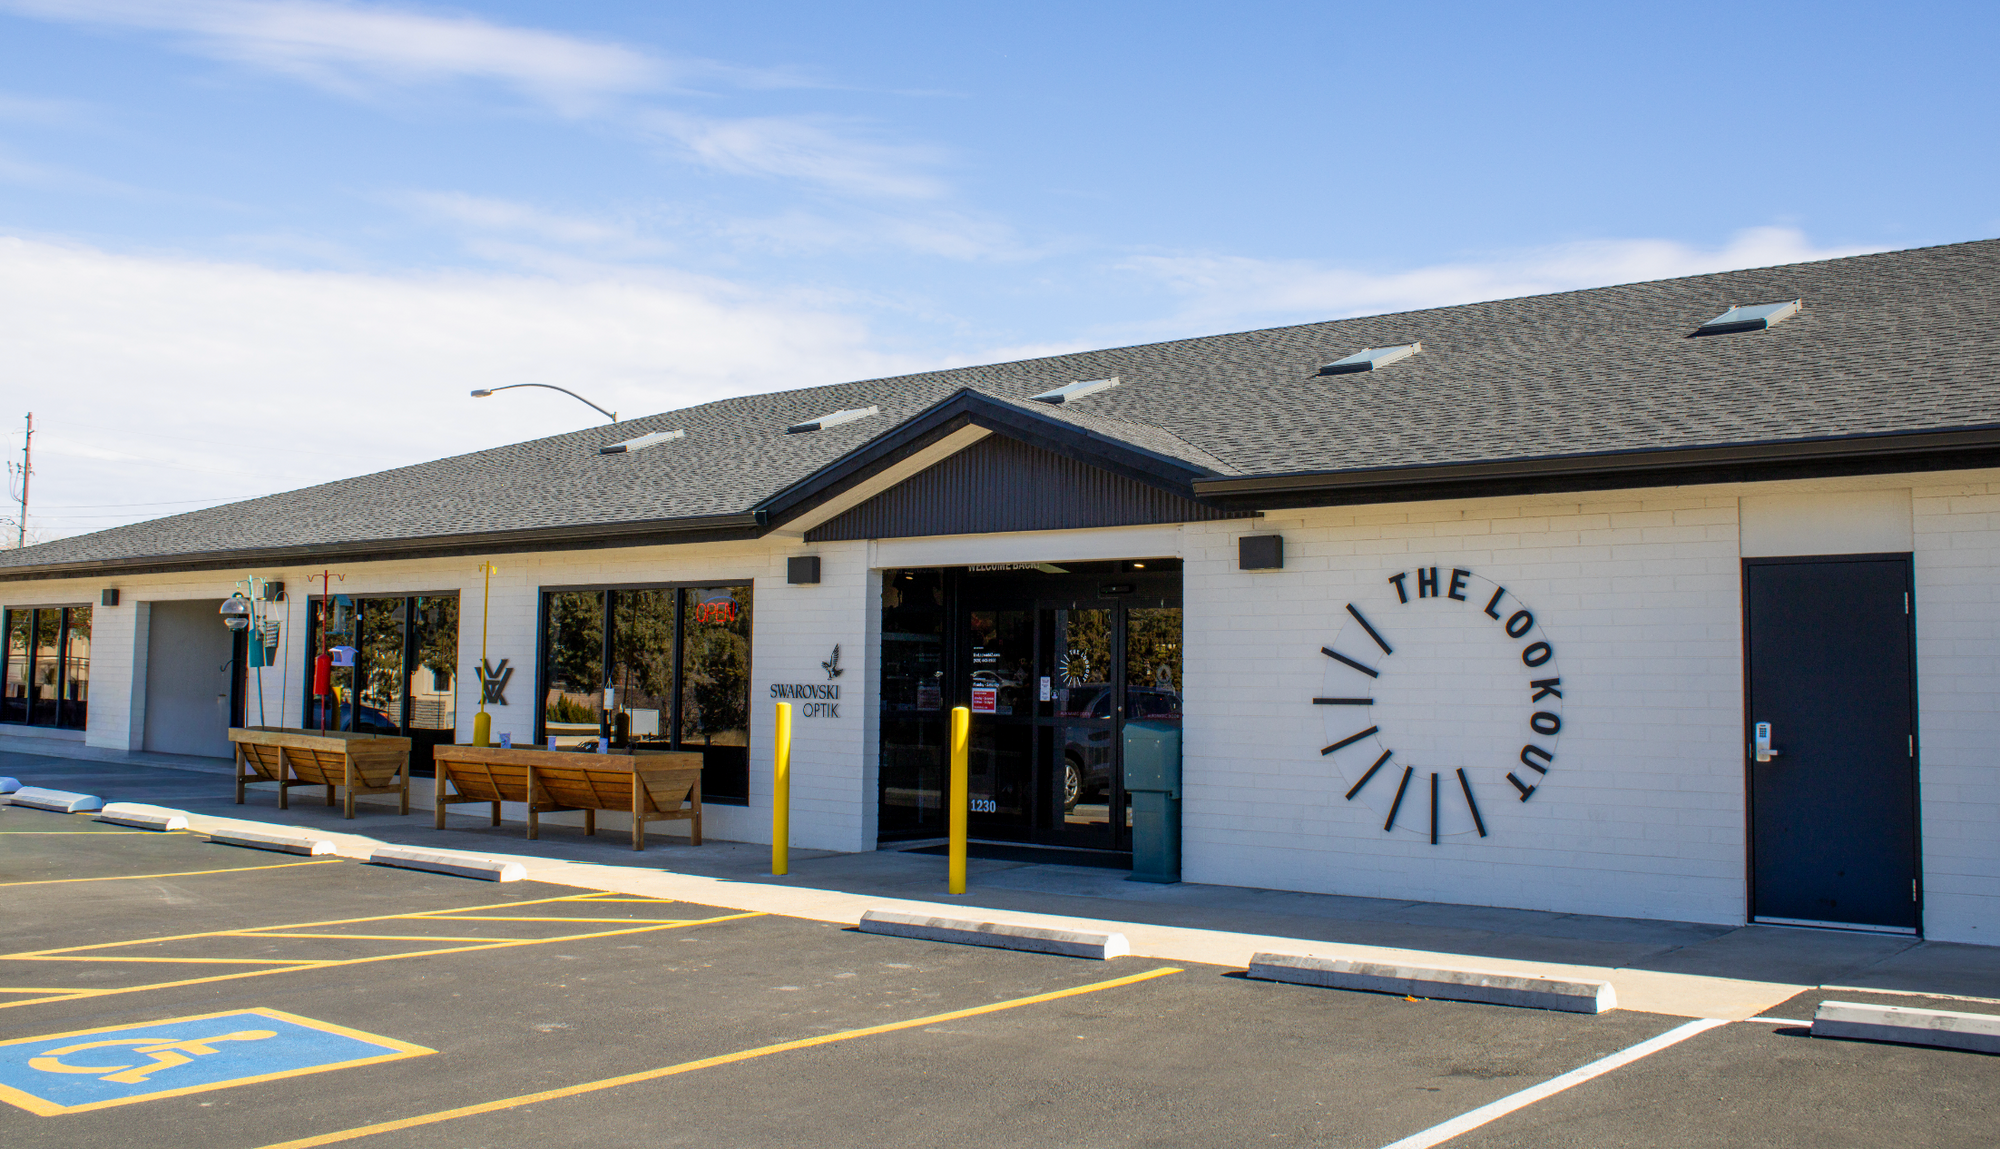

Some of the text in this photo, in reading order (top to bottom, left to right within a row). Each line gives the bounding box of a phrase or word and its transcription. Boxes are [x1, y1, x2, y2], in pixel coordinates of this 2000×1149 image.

[696, 602, 735, 622] OPEN
[769, 683, 840, 699] SWAROVSKI
[1388, 566, 1562, 803] THE LOOKOUT
[802, 702, 840, 718] OPTIK
[970, 799, 996, 813] 1230
